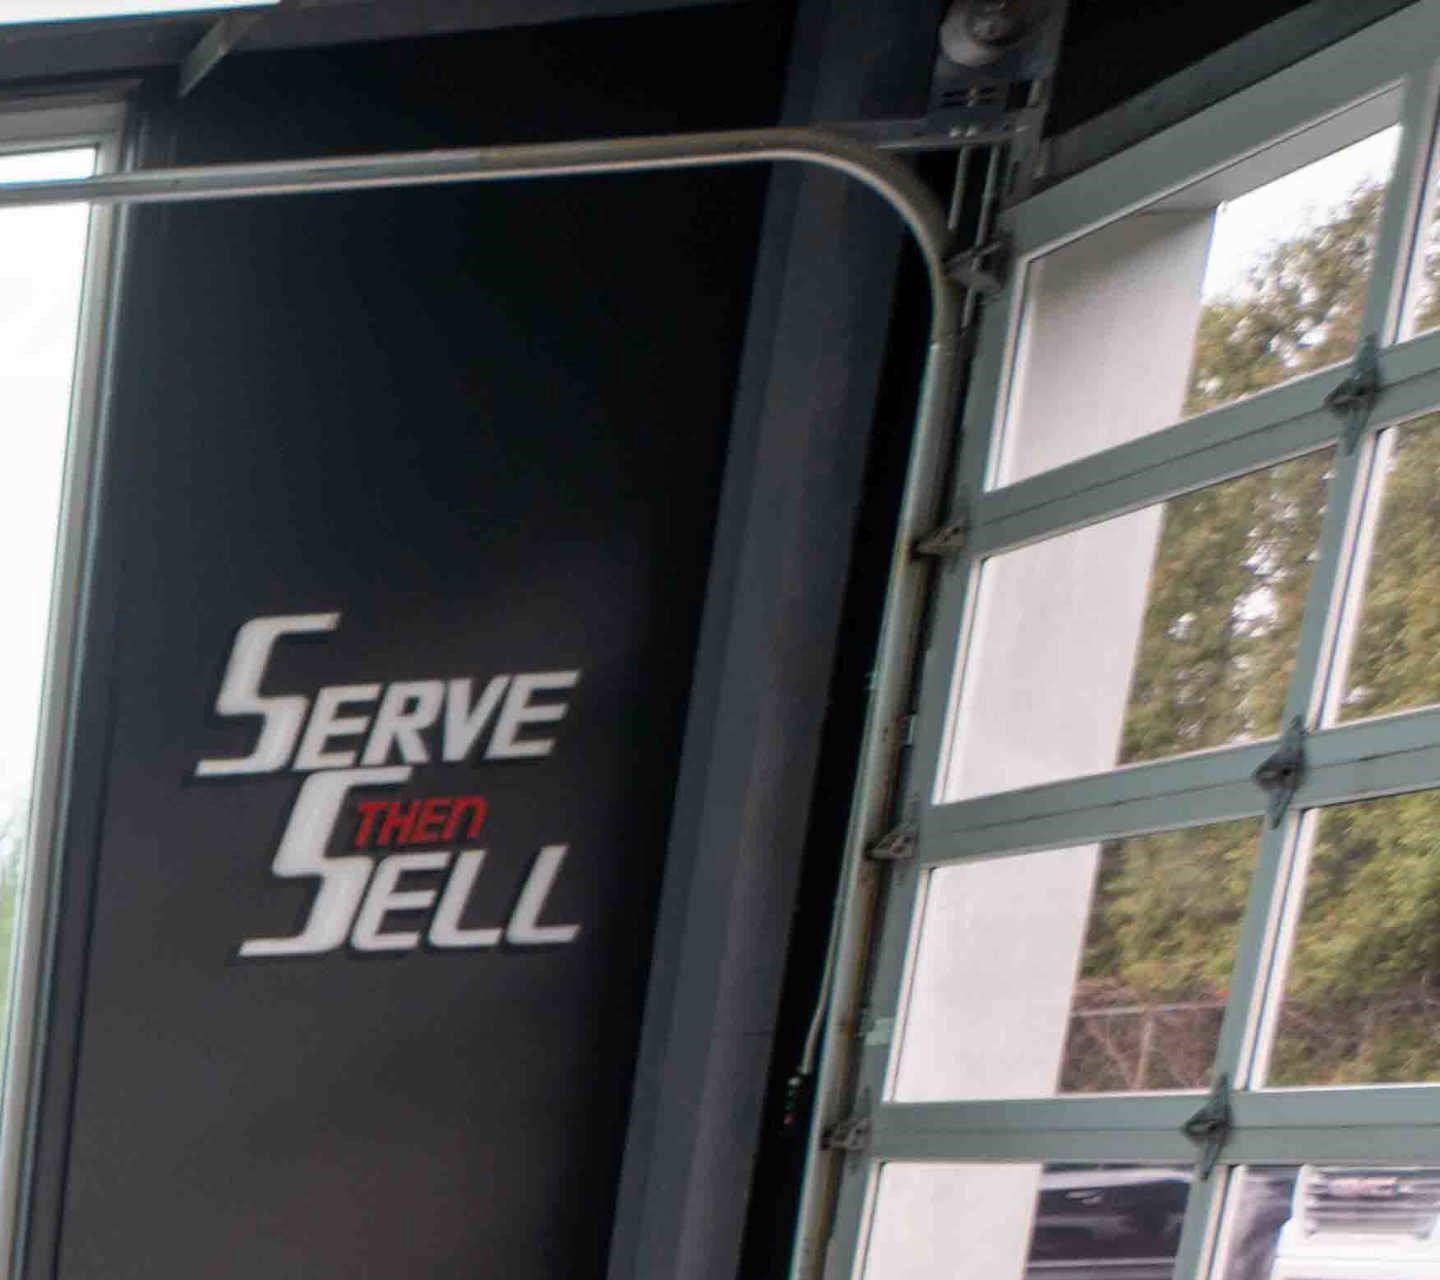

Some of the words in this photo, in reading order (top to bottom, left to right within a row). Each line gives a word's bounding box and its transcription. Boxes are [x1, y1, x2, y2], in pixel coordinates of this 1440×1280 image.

[194, 612, 581, 777] SERVE
[238, 766, 581, 958] SELL
[355, 795, 488, 848] THEN
